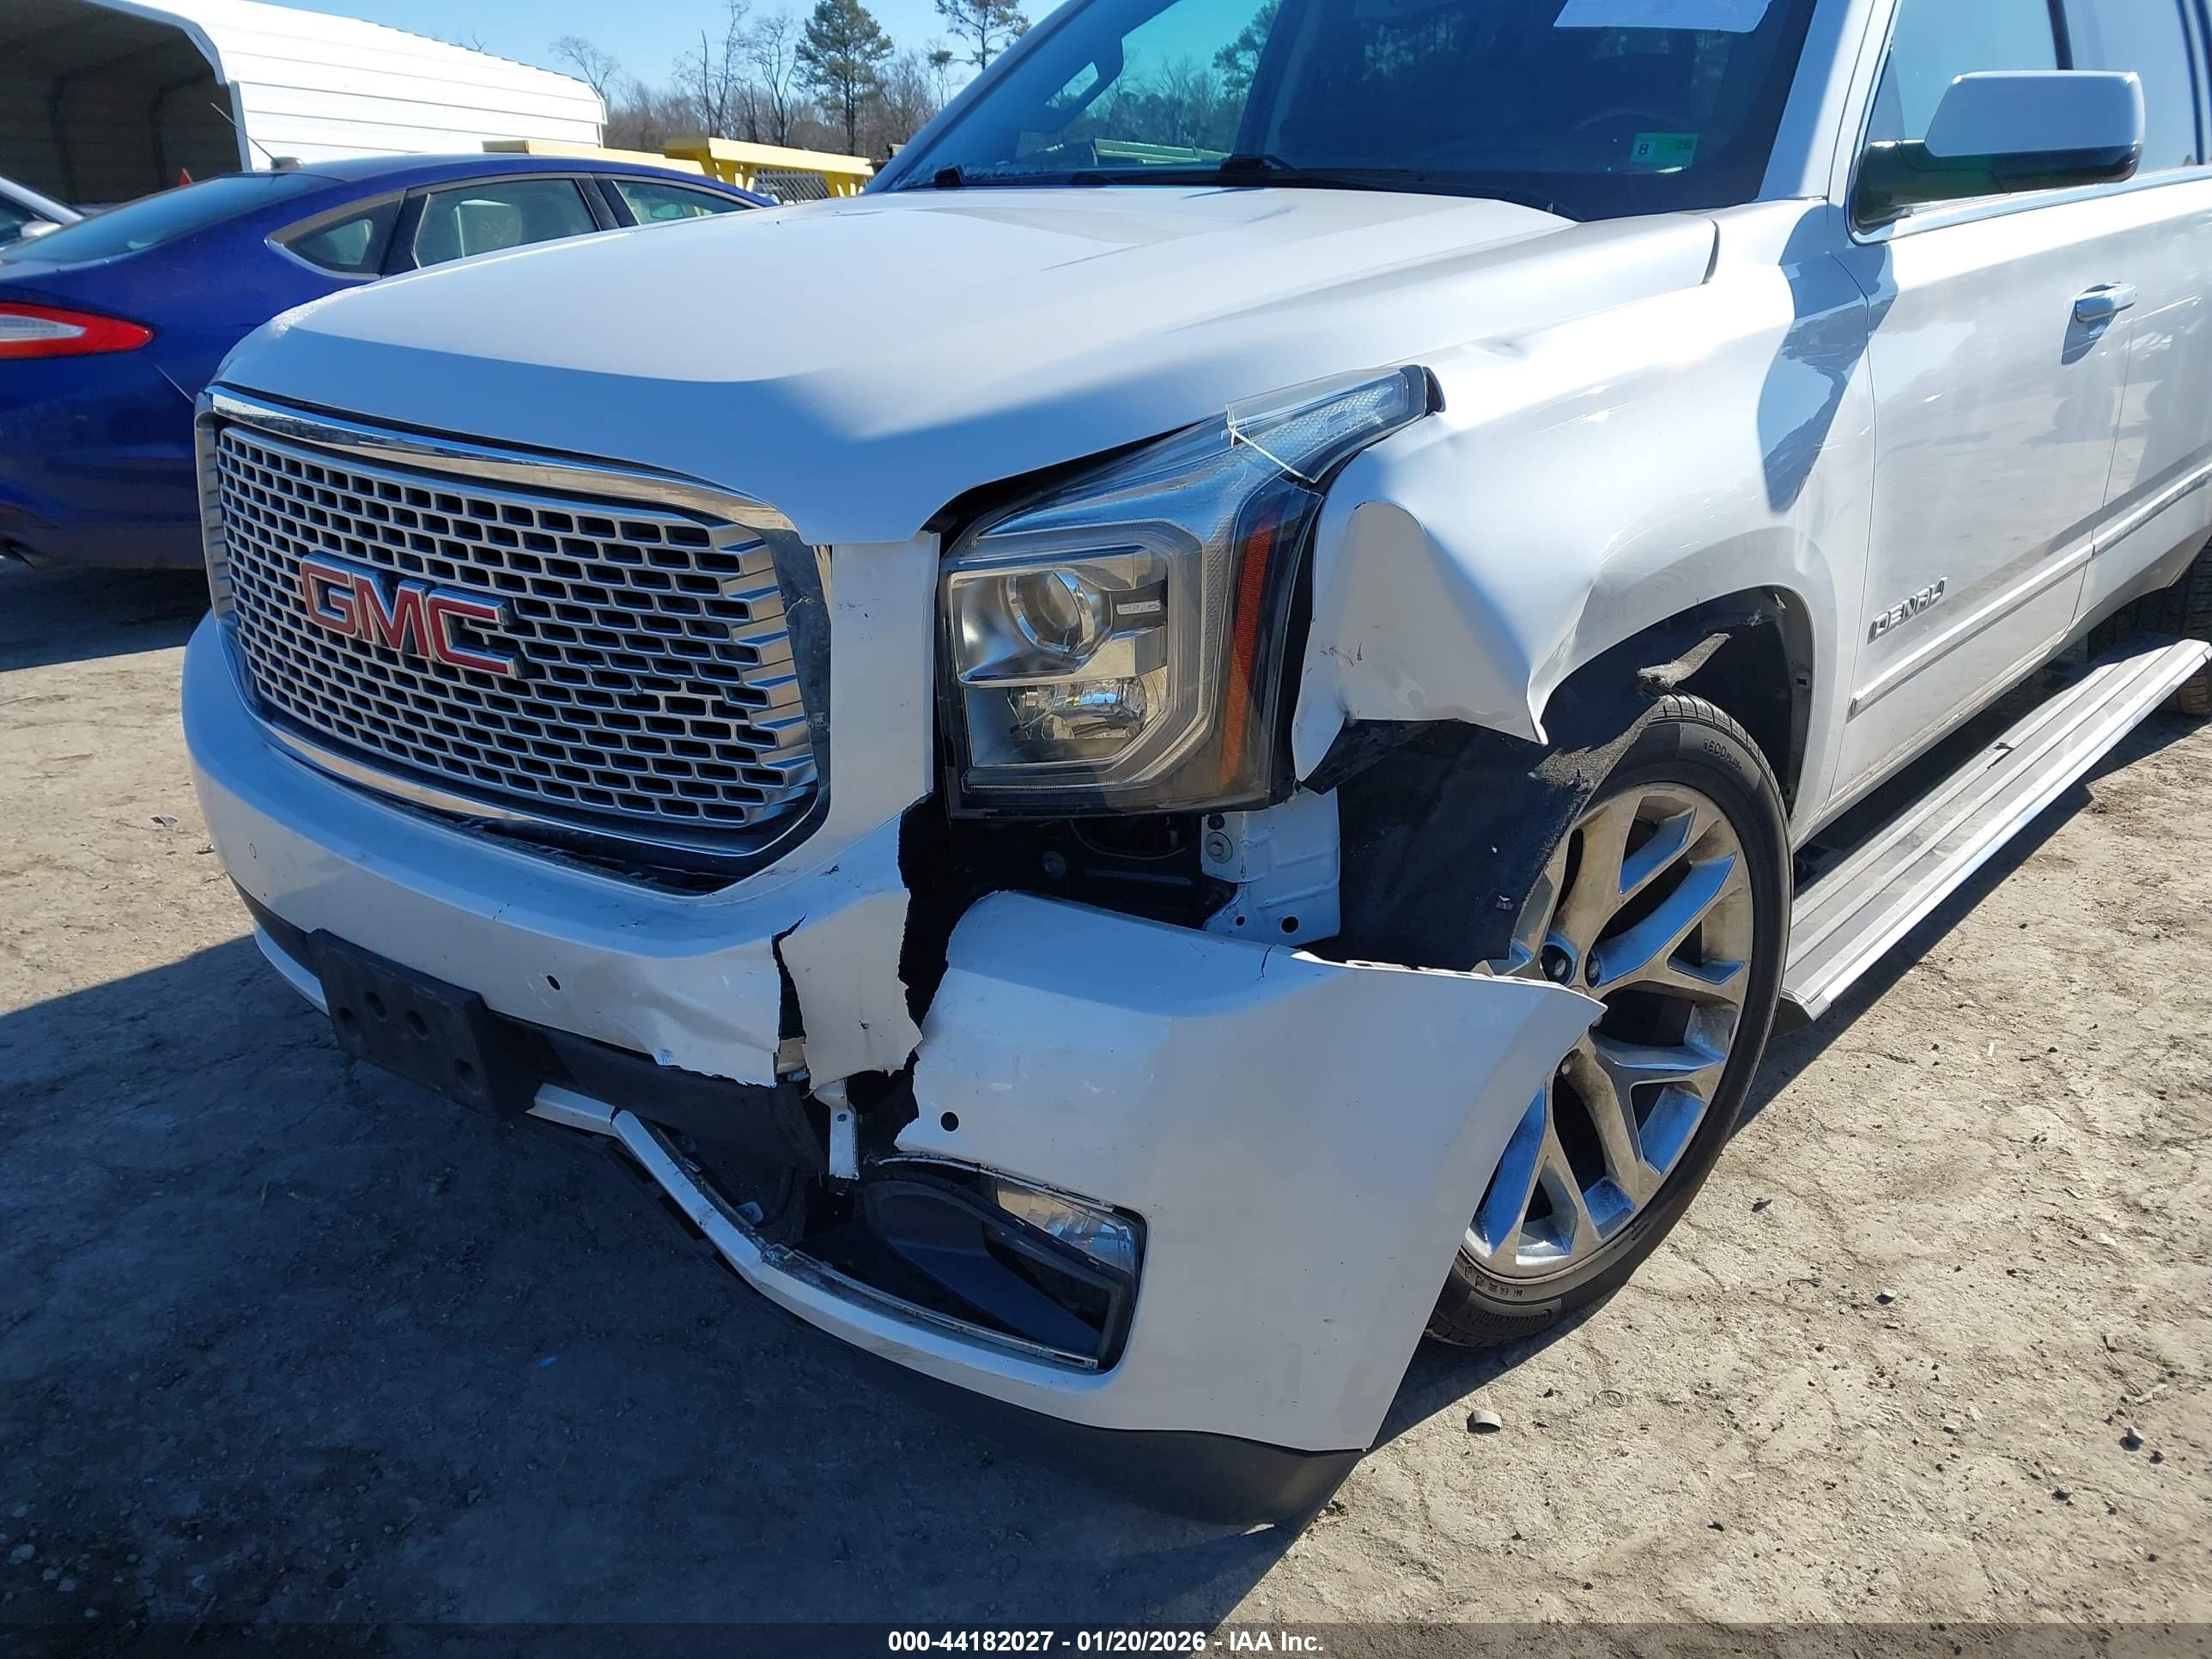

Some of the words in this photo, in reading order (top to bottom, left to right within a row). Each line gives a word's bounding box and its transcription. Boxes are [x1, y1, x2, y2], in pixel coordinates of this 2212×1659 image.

[1638, 144, 1649, 155] 8
[300, 550, 518, 680] GMC
[1867, 576, 1948, 645] DENALI
